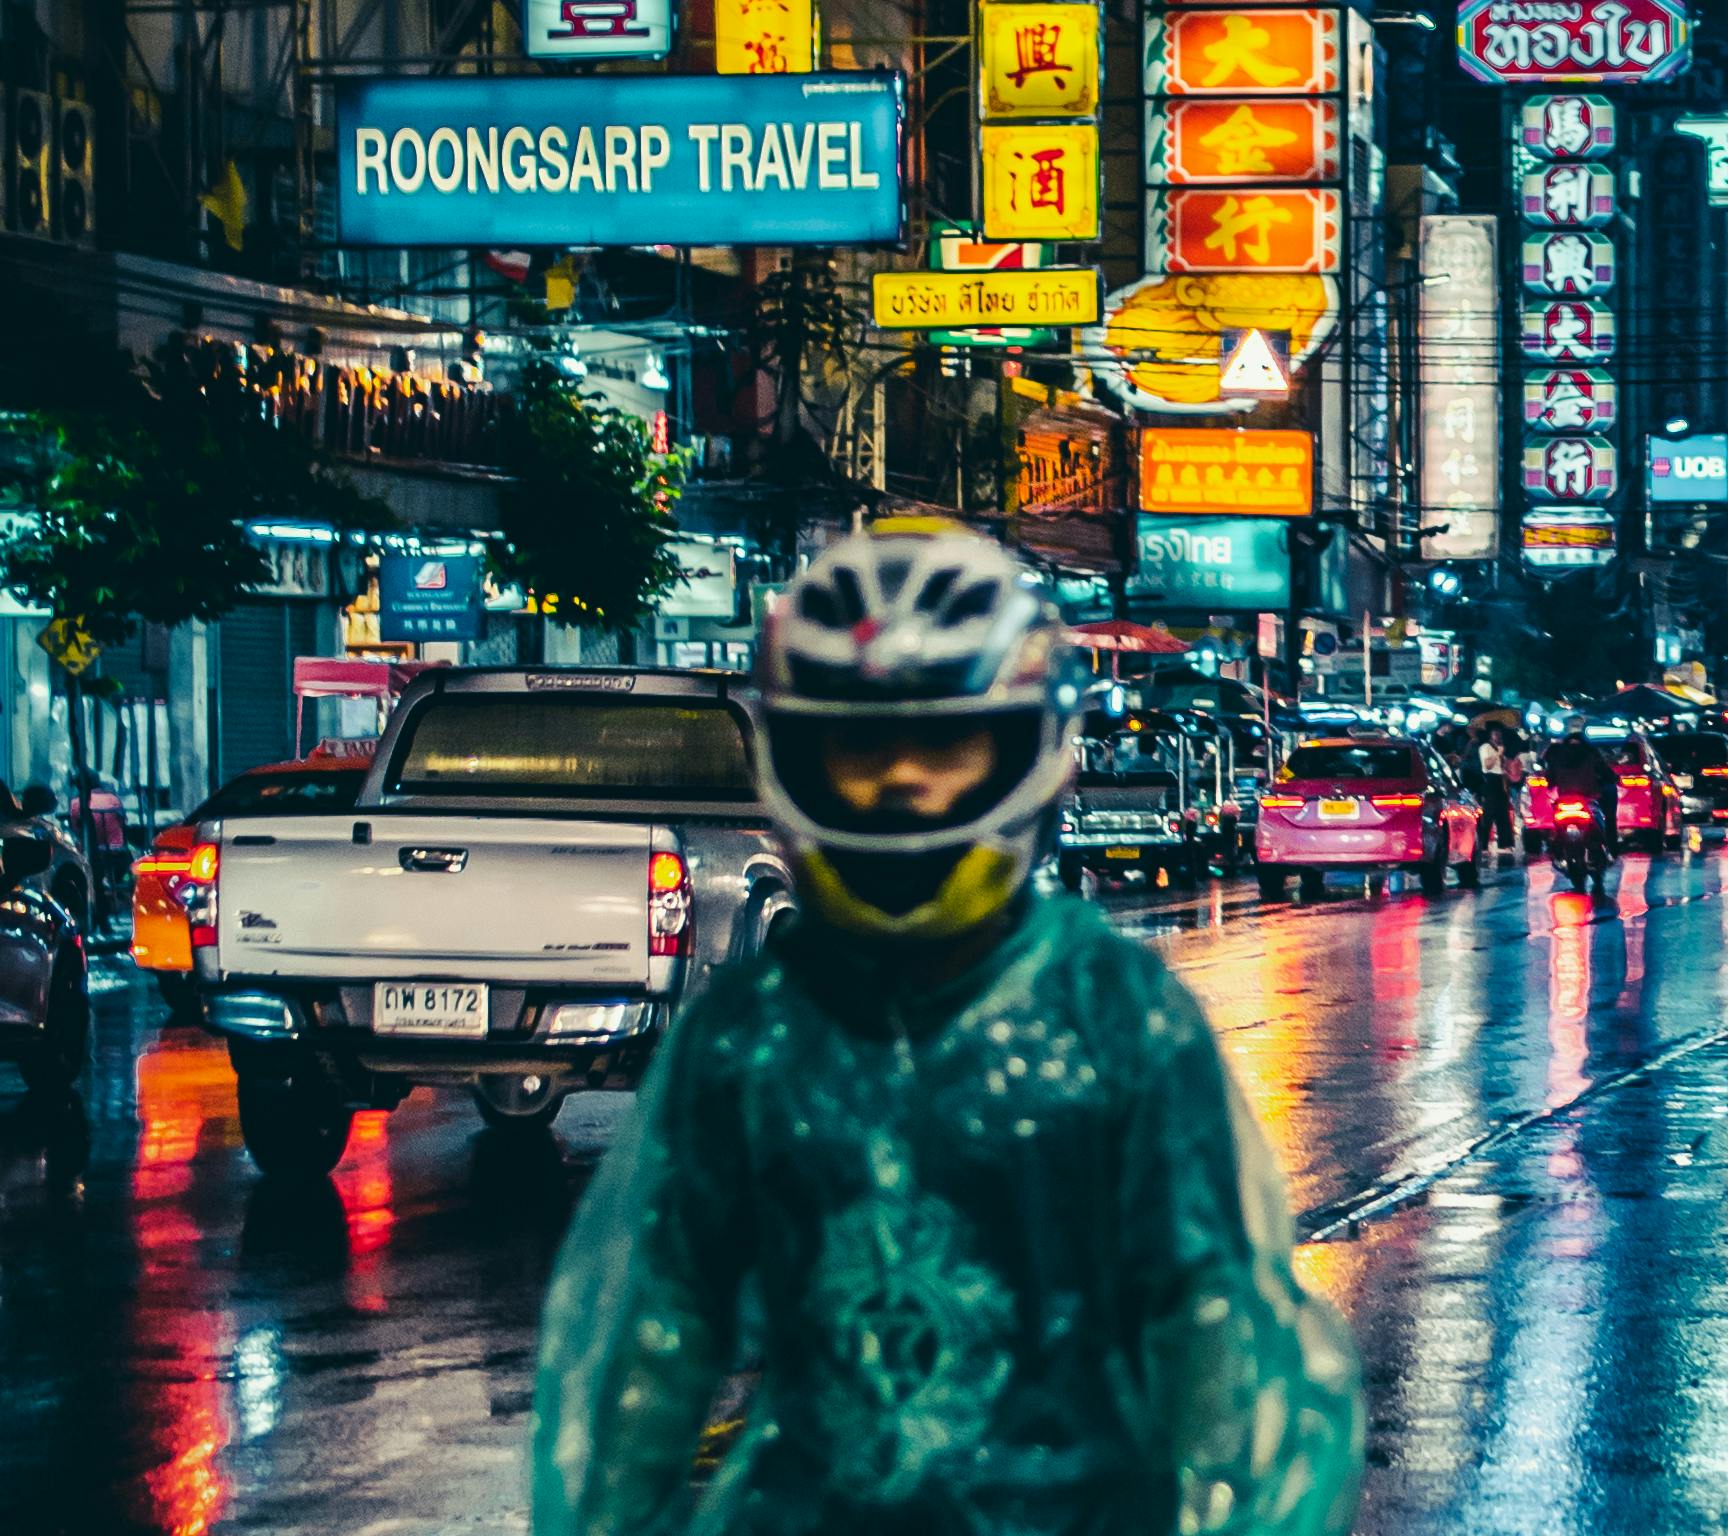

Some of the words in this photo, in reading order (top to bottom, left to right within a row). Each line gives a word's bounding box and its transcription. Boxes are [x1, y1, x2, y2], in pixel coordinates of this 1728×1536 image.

[1483, 1, 1666, 69] ทองใบ
[356, 127, 670, 194] ROONGSARP
[688, 122, 880, 192] TRAVEL
[1674, 456, 1727, 479] UOB
[424, 988, 477, 1012] 8172
